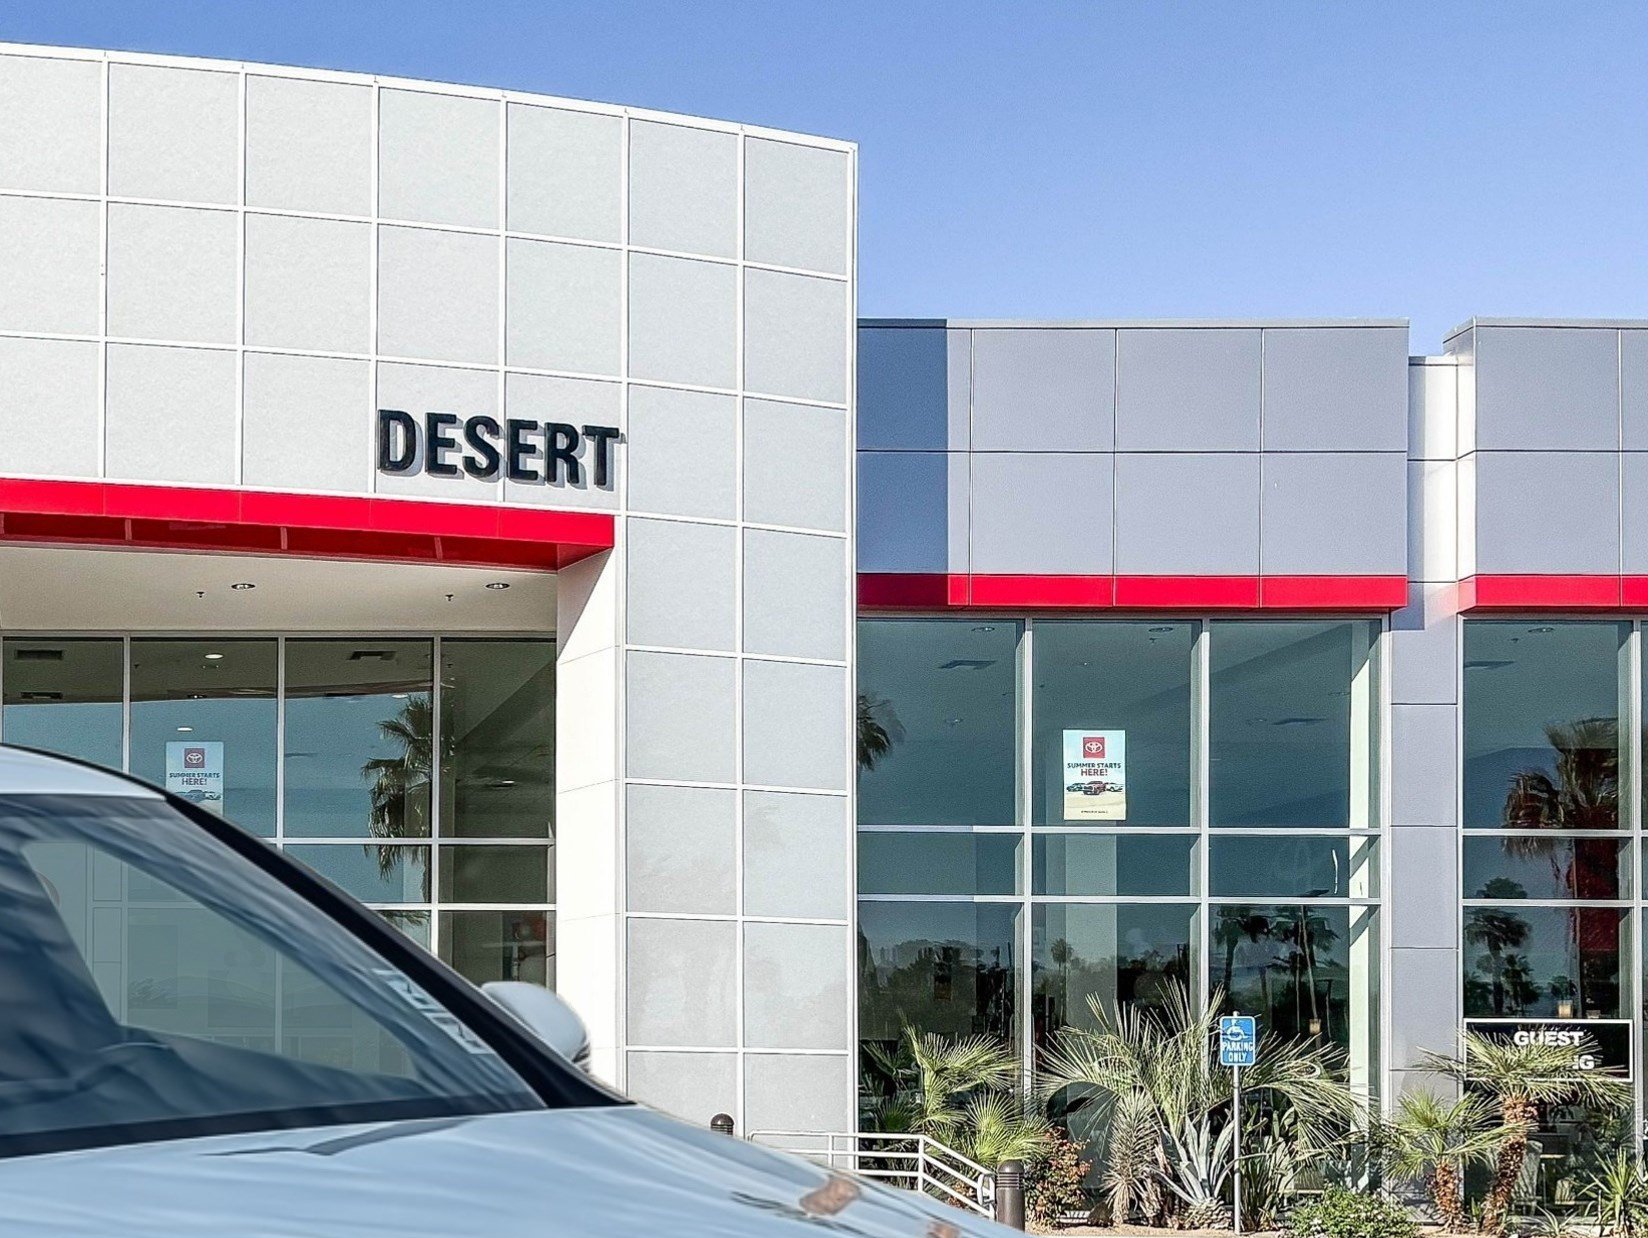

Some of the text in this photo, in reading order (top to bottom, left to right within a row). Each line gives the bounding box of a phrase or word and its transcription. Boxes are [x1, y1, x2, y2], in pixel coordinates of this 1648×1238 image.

[376, 408, 620, 486] DESERT
[1080, 768, 1108, 776] HERE!
[181, 778, 207, 786] HERE!
[1513, 1030, 1585, 1047] GUEST
[1222, 1041, 1253, 1052] PARKING
[1228, 1052, 1247, 1062] ONLY
